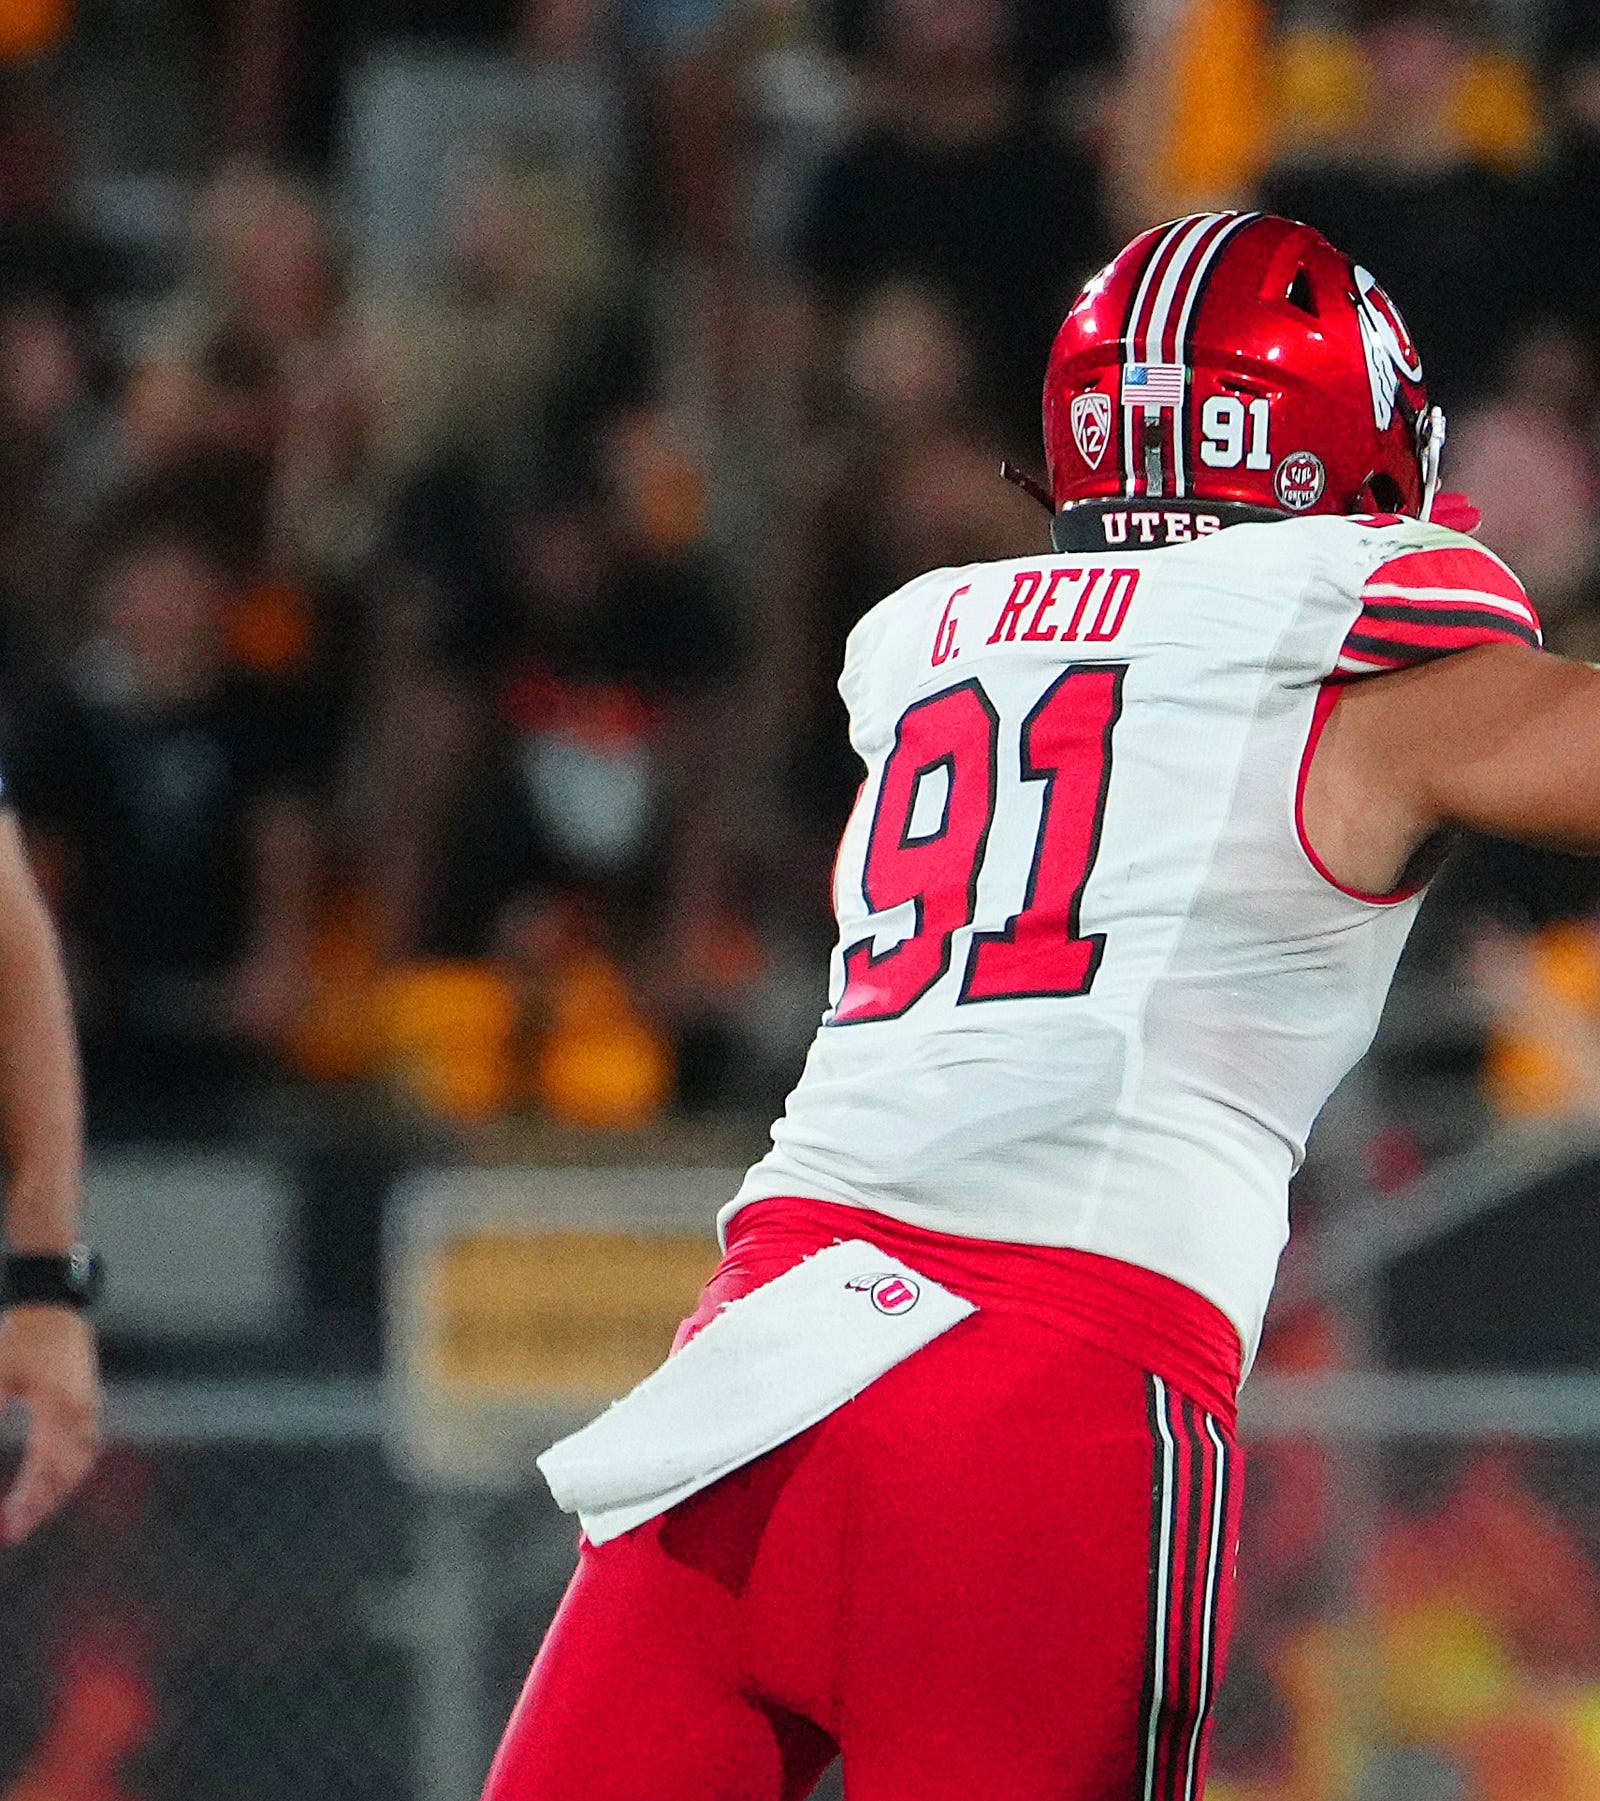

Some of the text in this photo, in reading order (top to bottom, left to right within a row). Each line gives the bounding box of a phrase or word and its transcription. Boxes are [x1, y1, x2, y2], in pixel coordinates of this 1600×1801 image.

[1082, 425, 1103, 453] 12
[1200, 395, 1273, 470] 91
[1101, 511, 1221, 545] UTES
[931, 568, 1140, 667] G. REID
[825, 663, 1131, 1027] 91
[876, 1279, 915, 1310] U
